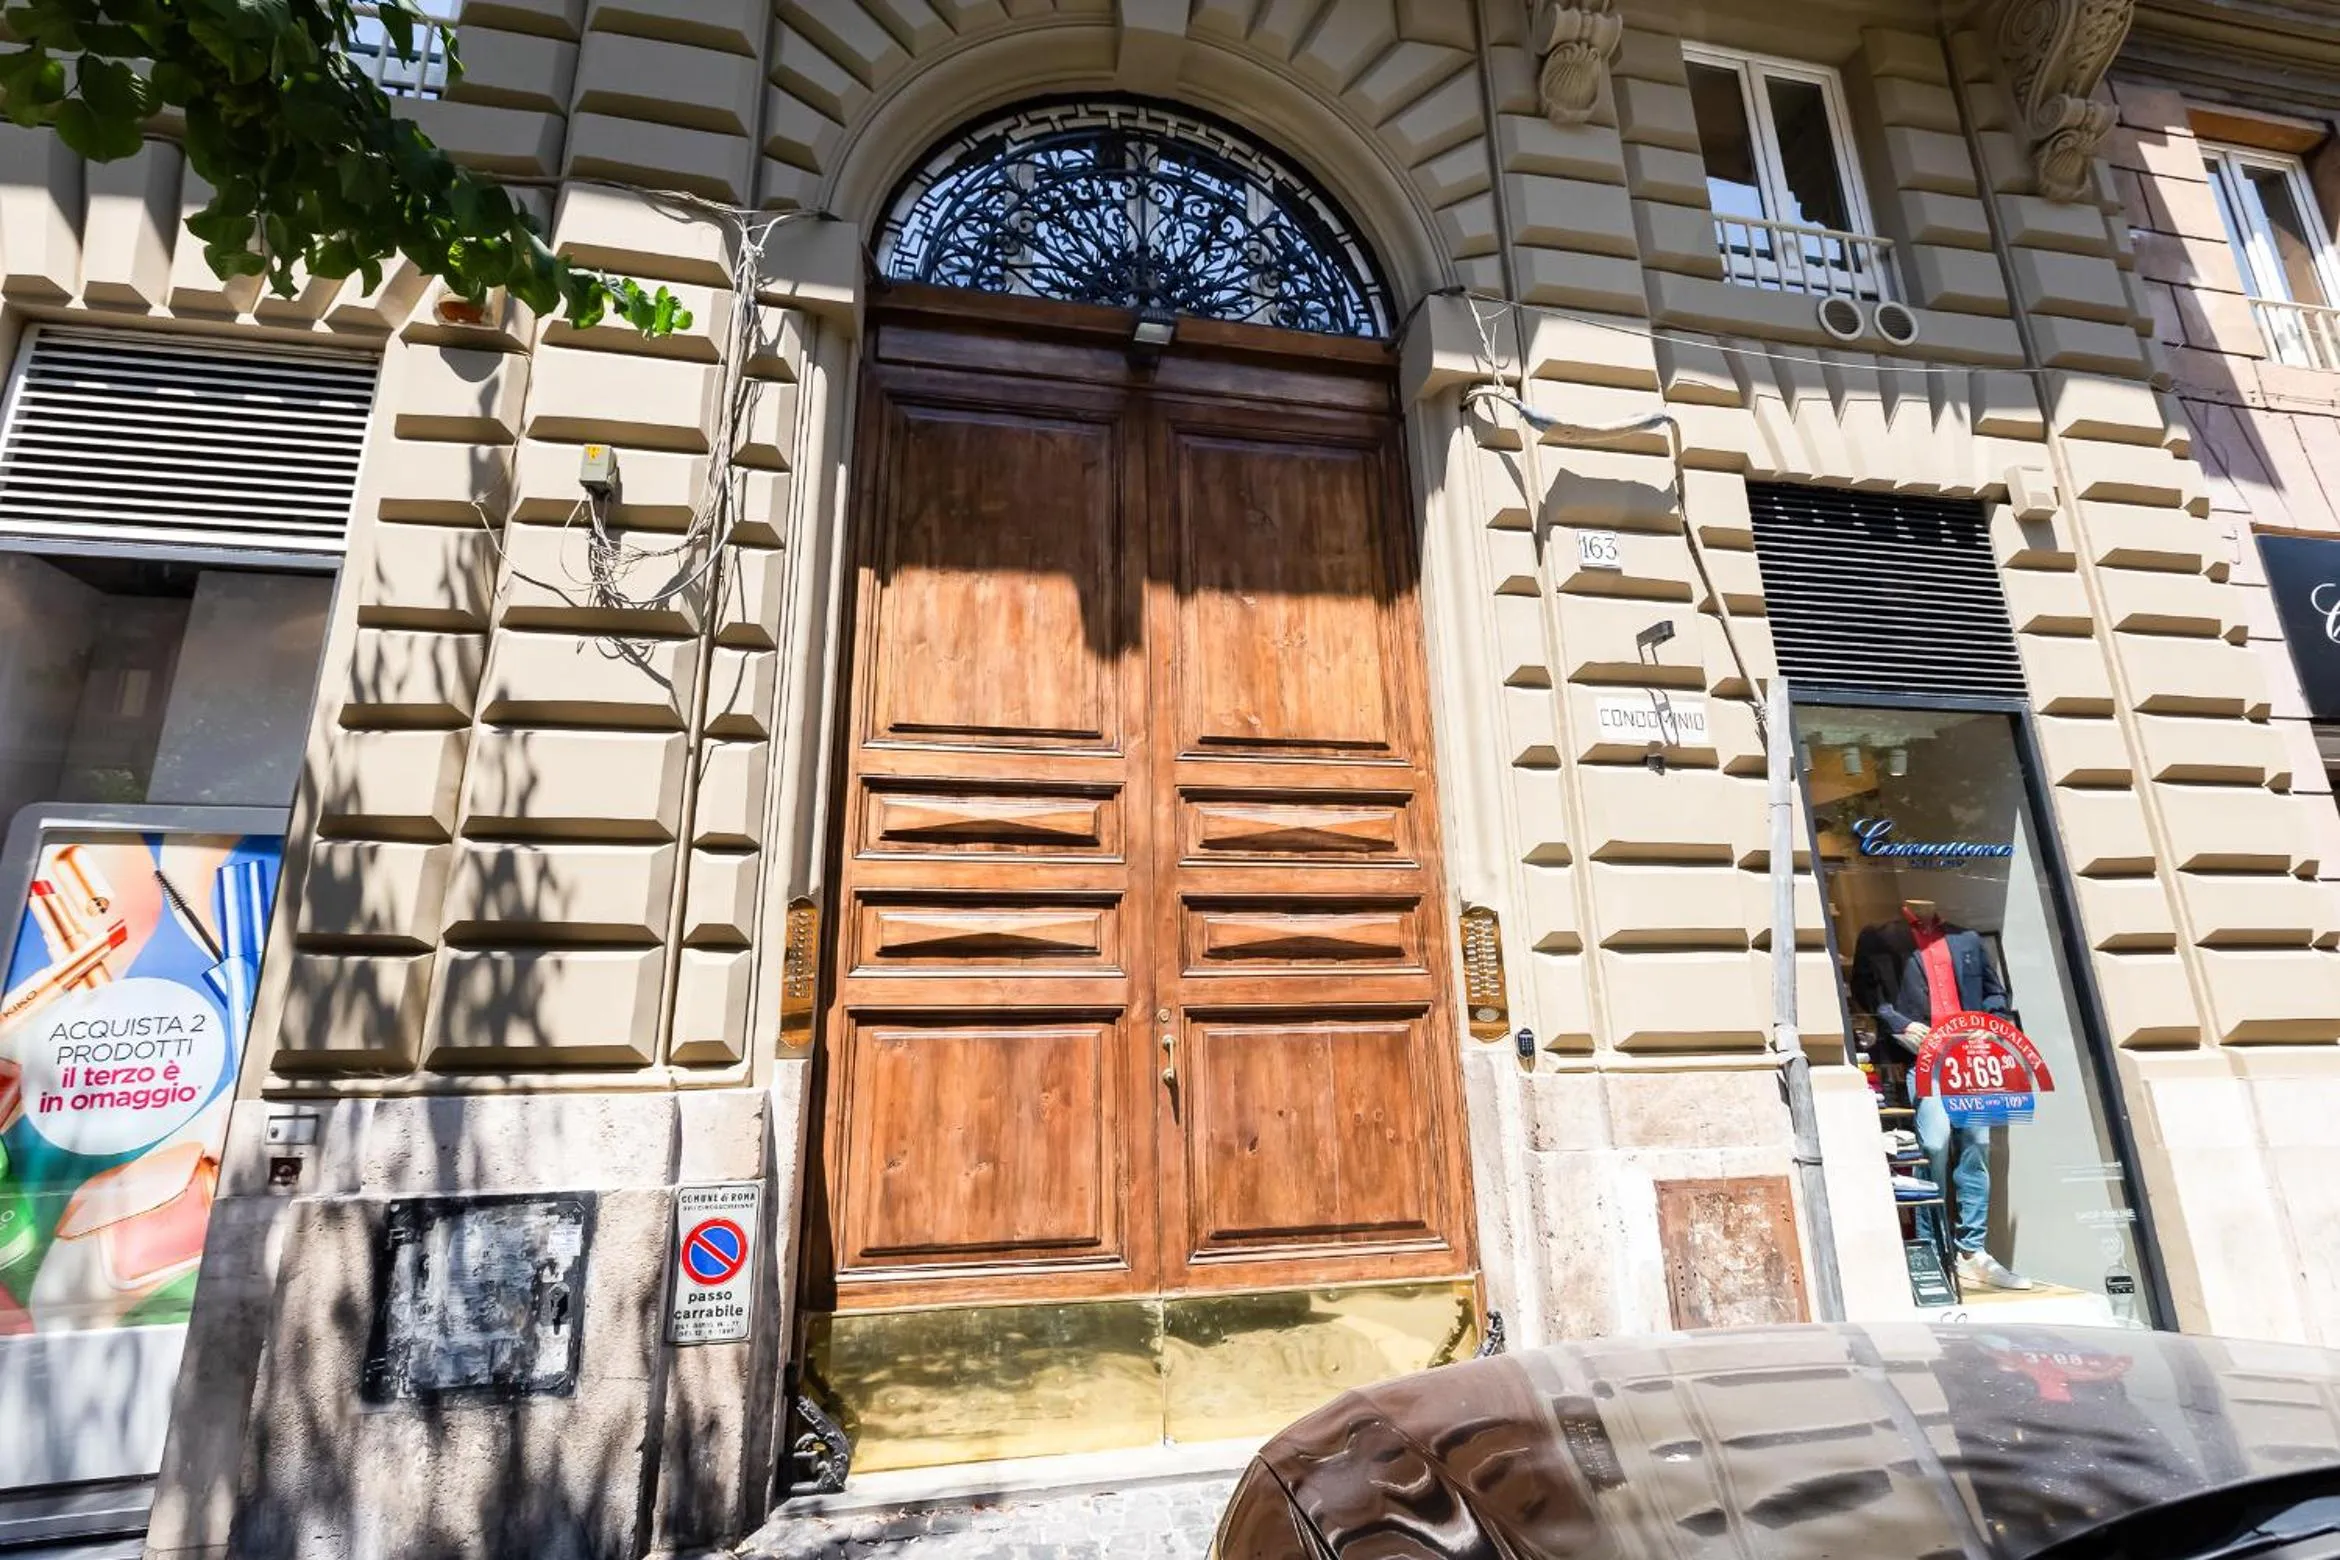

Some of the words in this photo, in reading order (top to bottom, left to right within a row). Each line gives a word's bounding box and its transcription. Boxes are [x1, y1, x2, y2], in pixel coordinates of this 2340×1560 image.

[1582, 535, 1617, 561] 163
[1600, 708, 1705, 731] CONDOMINIO
[49, 1015, 184, 1041] ACQUISTA
[189, 1014, 206, 1032] 2
[1970, 1014, 1986, 1027] DI
[56, 1038, 193, 1065] PRODOTTI
[61, 1067, 76, 1088] il
[84, 1066, 156, 1087] terzo
[163, 1060, 180, 1081] è
[39, 1092, 63, 1113] in
[1949, 1096, 1985, 1111] SAVE
[731, 1192, 756, 1202] ROMA
[688, 1290, 733, 1304] passo
[673, 1304, 744, 1320] carrabile
